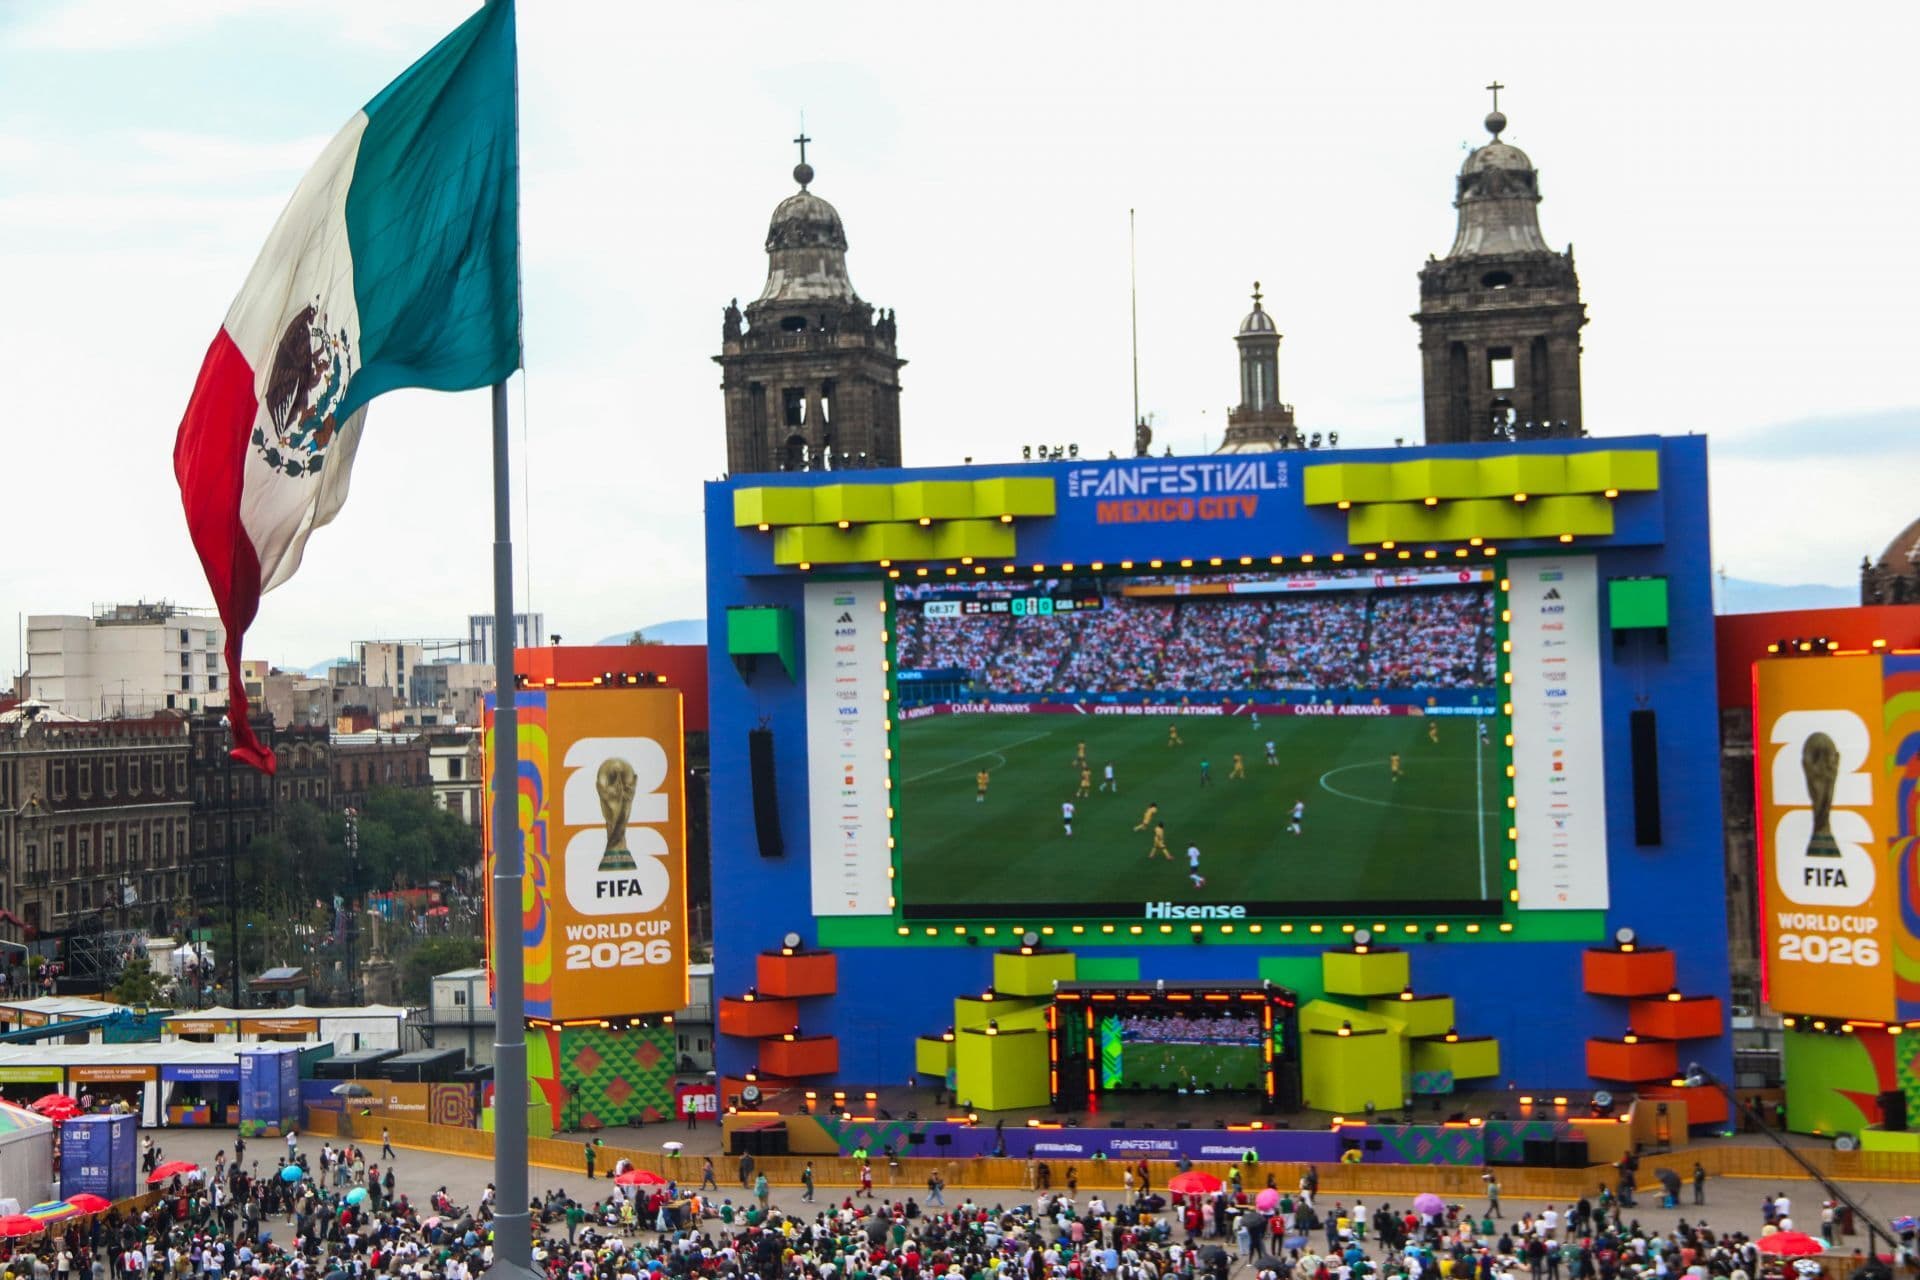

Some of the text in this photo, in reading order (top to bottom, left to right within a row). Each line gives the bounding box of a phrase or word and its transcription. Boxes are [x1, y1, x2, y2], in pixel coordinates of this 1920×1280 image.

[1069, 470, 1079, 497] FIFA
[1277, 461, 1288, 488] 2026
[1097, 495, 1259, 524] MEXICO CITY
[1545, 689, 1567, 697] VISA
[838, 707, 859, 715] VISA
[952, 703, 1030, 713] QATAR AIRWAYS
[1094, 706, 1123, 715] OVER
[1294, 704, 1390, 715] QATAR AIRWAYS
[1770, 709, 1873, 805] 2
[563, 737, 669, 825] 2
[1775, 809, 1876, 907] 6
[565, 826, 670, 916] 6
[1804, 867, 1848, 888] FIFA
[596, 879, 643, 898] FIFA
[1145, 901, 1247, 919] Hisense
[566, 920, 671, 941] WORLD CUP
[1778, 912, 1878, 933] WORLD CUP
[566, 940, 672, 970] 2026
[1778, 934, 1880, 966] 2026
